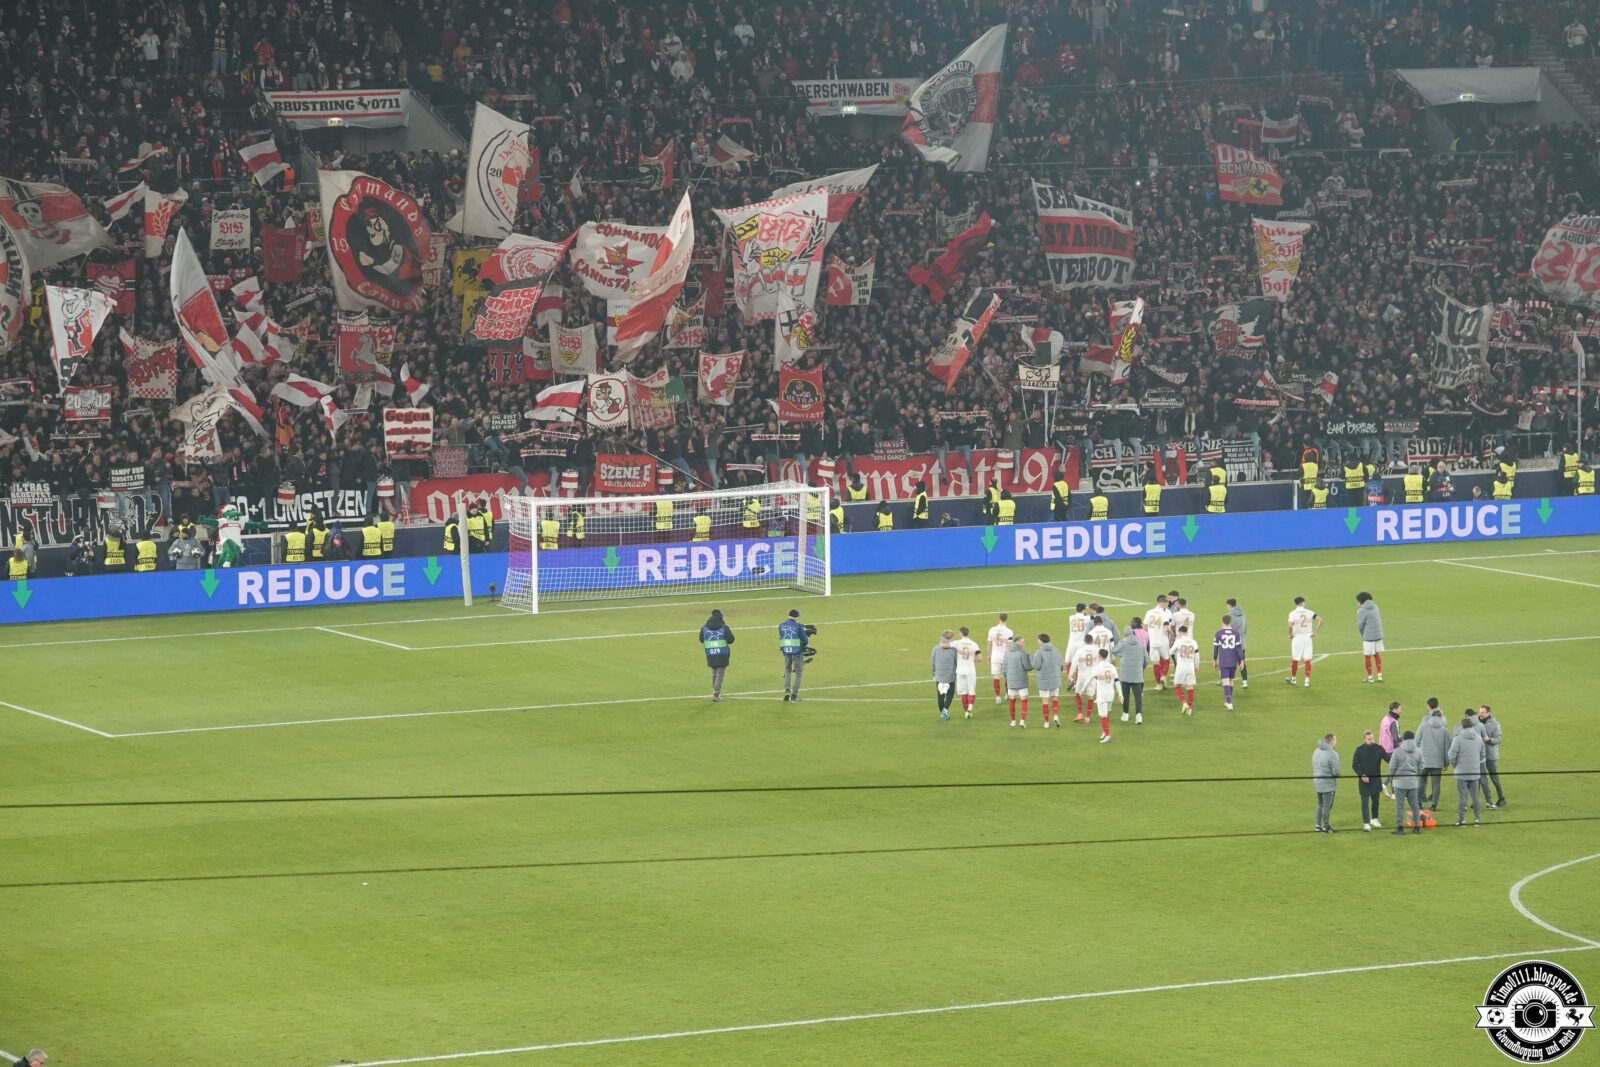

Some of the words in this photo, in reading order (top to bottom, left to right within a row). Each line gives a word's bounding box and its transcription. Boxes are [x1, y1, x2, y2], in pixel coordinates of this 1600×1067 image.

[272, 100, 354, 112] BRUSTRING
[370, 97, 400, 109] 0711
[1048, 256, 1130, 284] VERBOT
[385, 410, 431, 424] Gegen
[600, 463, 641, 480] SZENE
[643, 464, 651, 482] E
[1376, 503, 1521, 541] REDUCE
[1014, 521, 1166, 562] REDUCE
[638, 541, 796, 582] REDUCE
[238, 563, 405, 605] REDUCE
[1300, 614, 1307, 627] 2
[1221, 634, 1236, 649] 33
